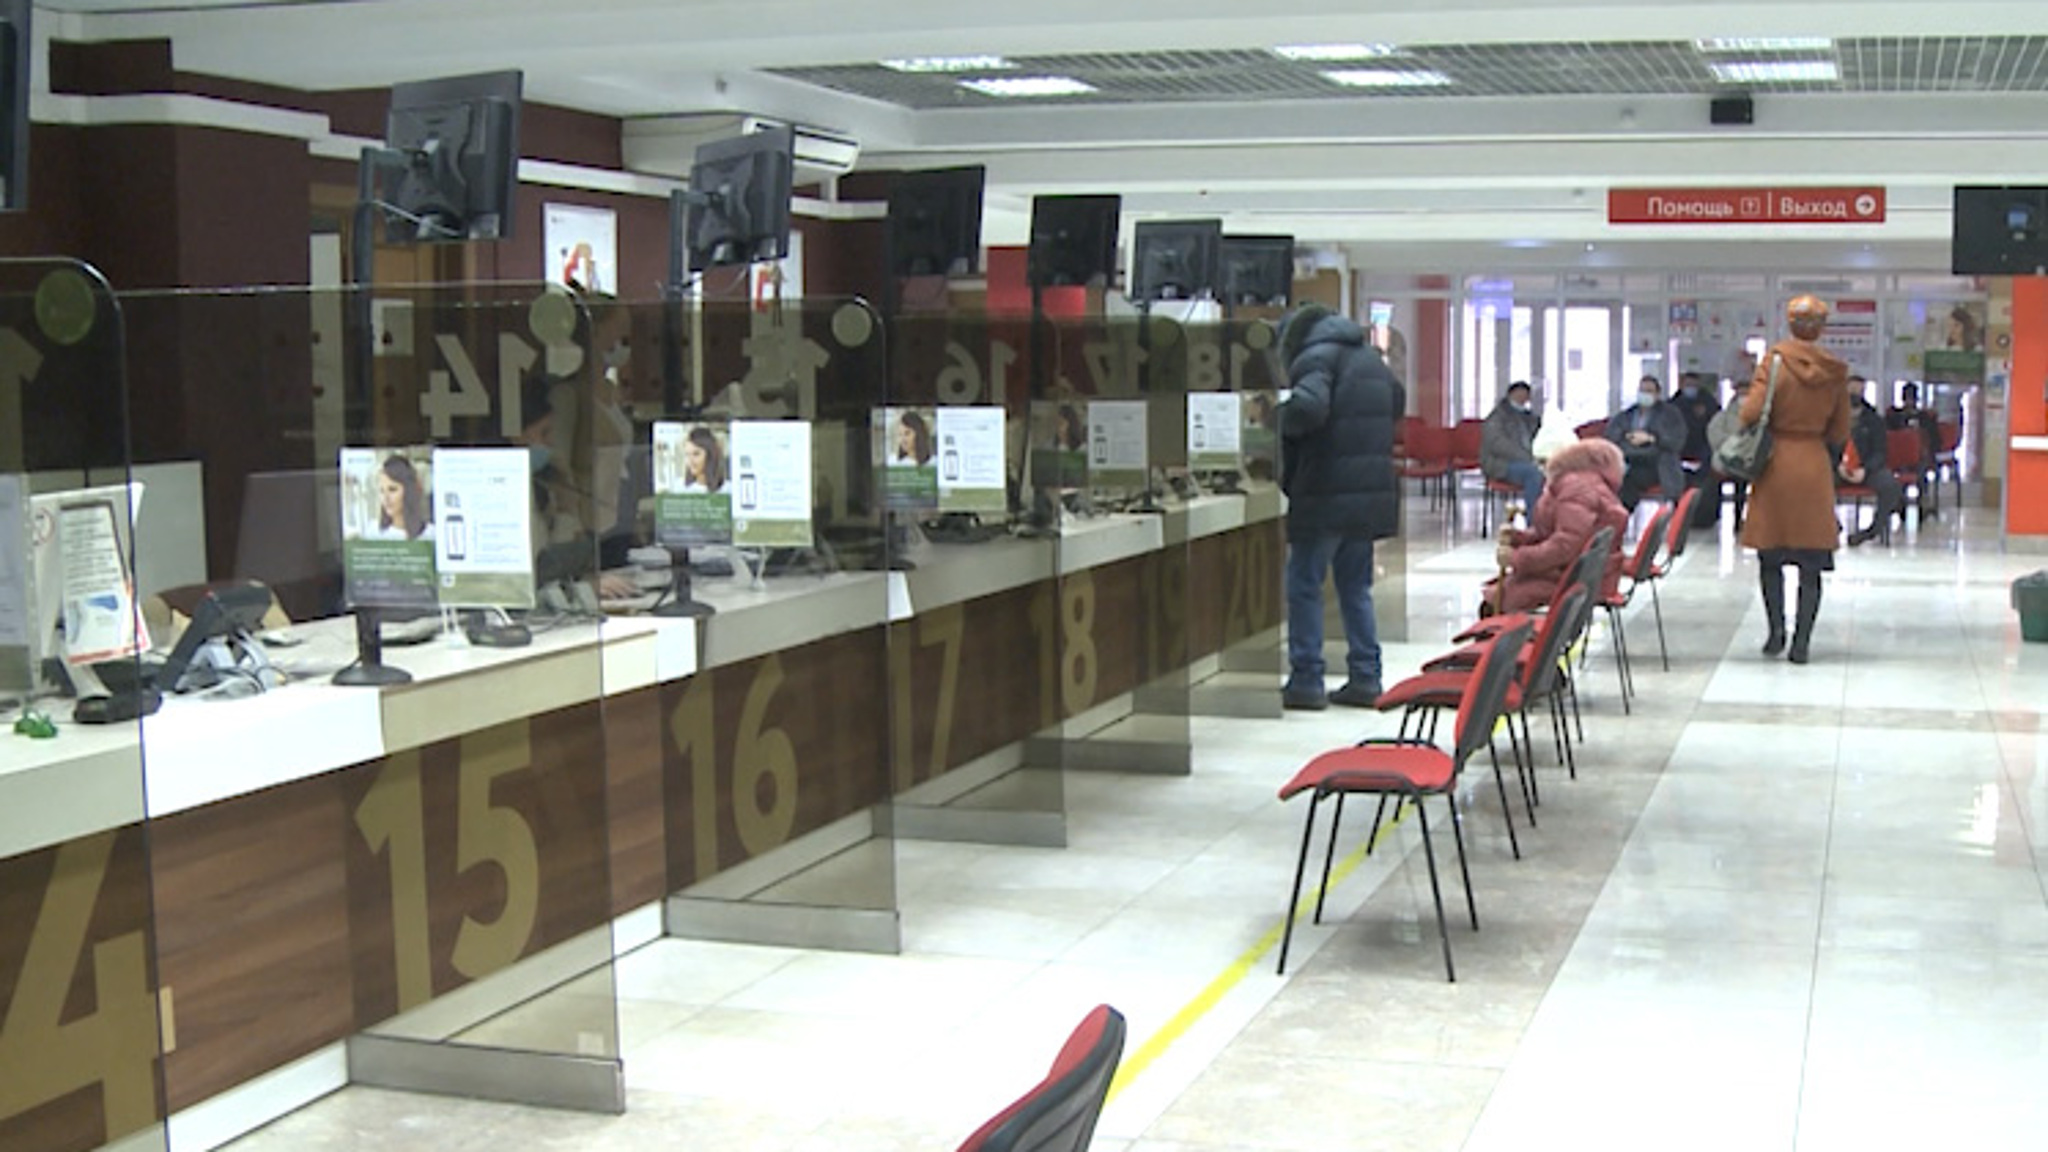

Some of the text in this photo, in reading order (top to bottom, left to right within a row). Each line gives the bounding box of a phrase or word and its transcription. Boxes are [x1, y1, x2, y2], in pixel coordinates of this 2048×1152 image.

[1647, 197, 1847, 218] Помощь Выход
[1029, 569, 1098, 735] 18
[1224, 532, 1269, 649] 20
[670, 651, 799, 884] 16
[887, 601, 965, 797] 17
[353, 717, 540, 1016] 15
[0, 830, 162, 1146] 4
